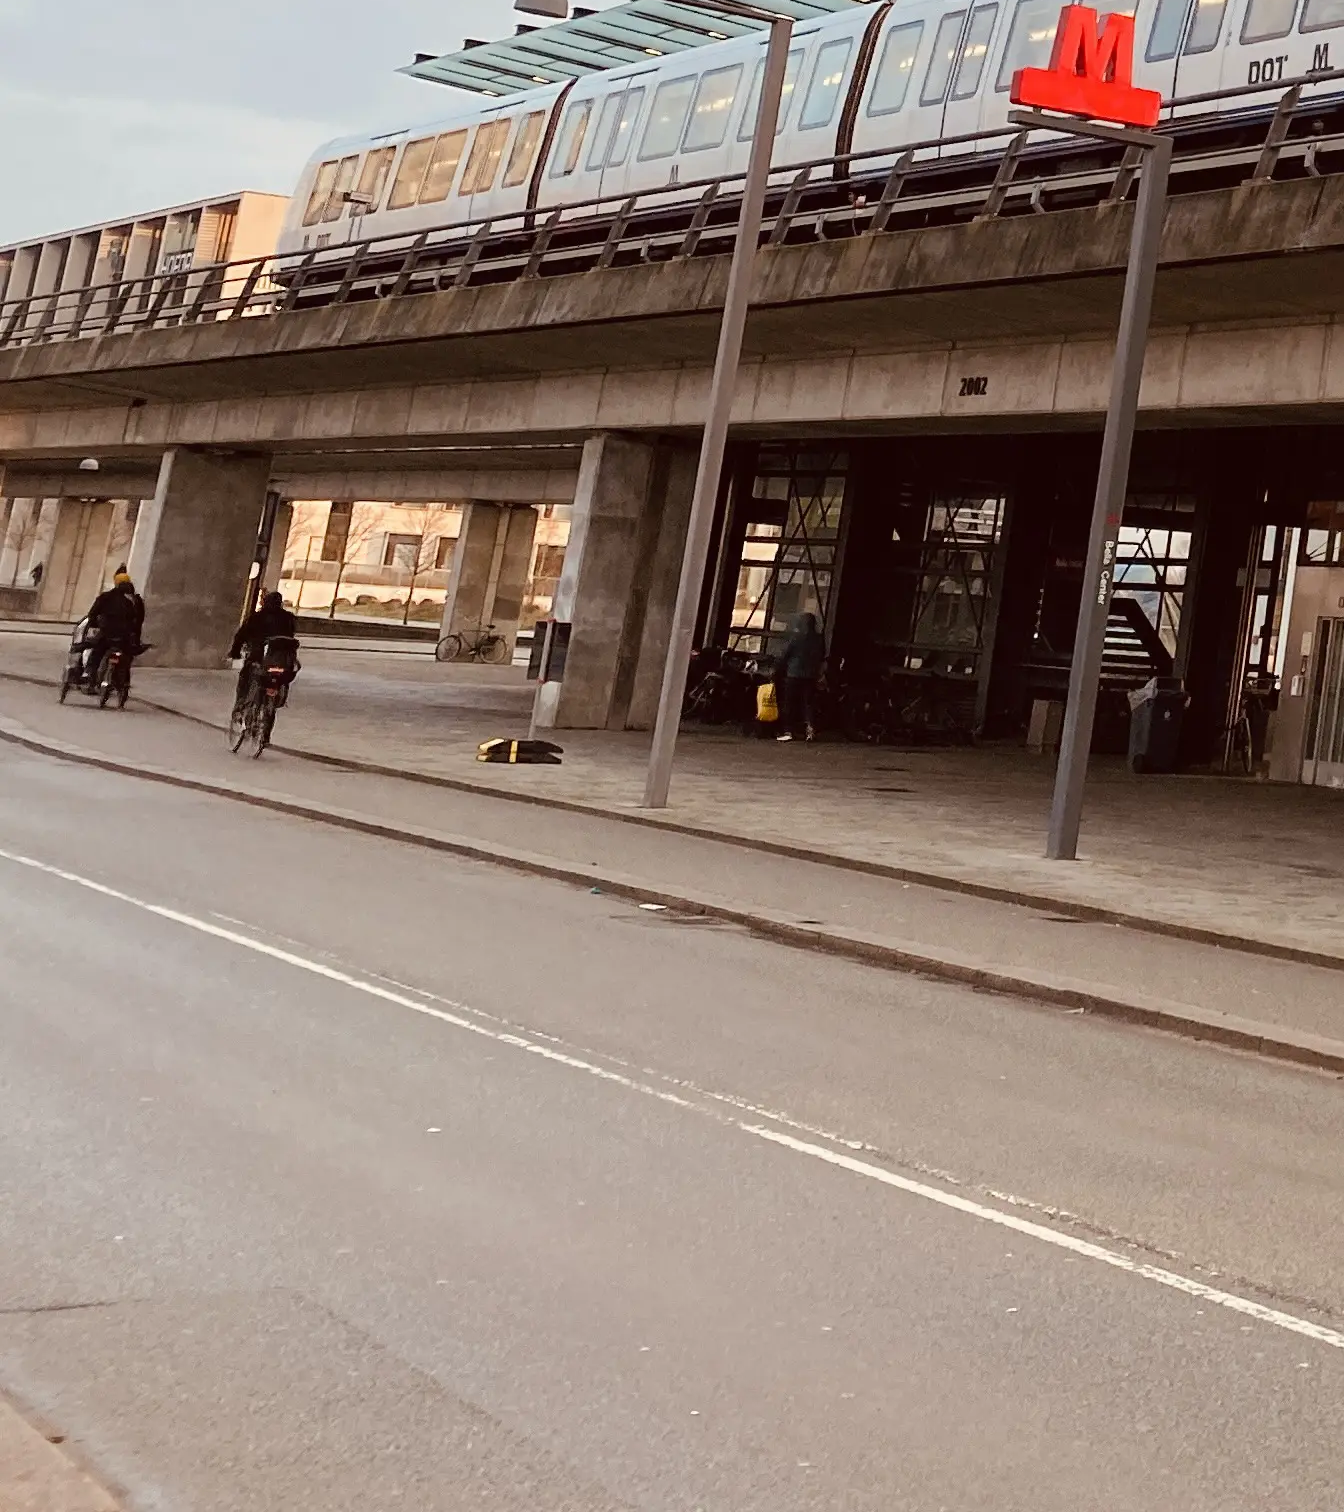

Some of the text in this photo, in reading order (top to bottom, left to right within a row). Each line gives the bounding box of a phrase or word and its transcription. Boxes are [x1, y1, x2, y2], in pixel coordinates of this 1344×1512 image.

[1010, 4, 1161, 127] M
[958, 376, 989, 397] 2002
[1097, 570, 1111, 605] Center
